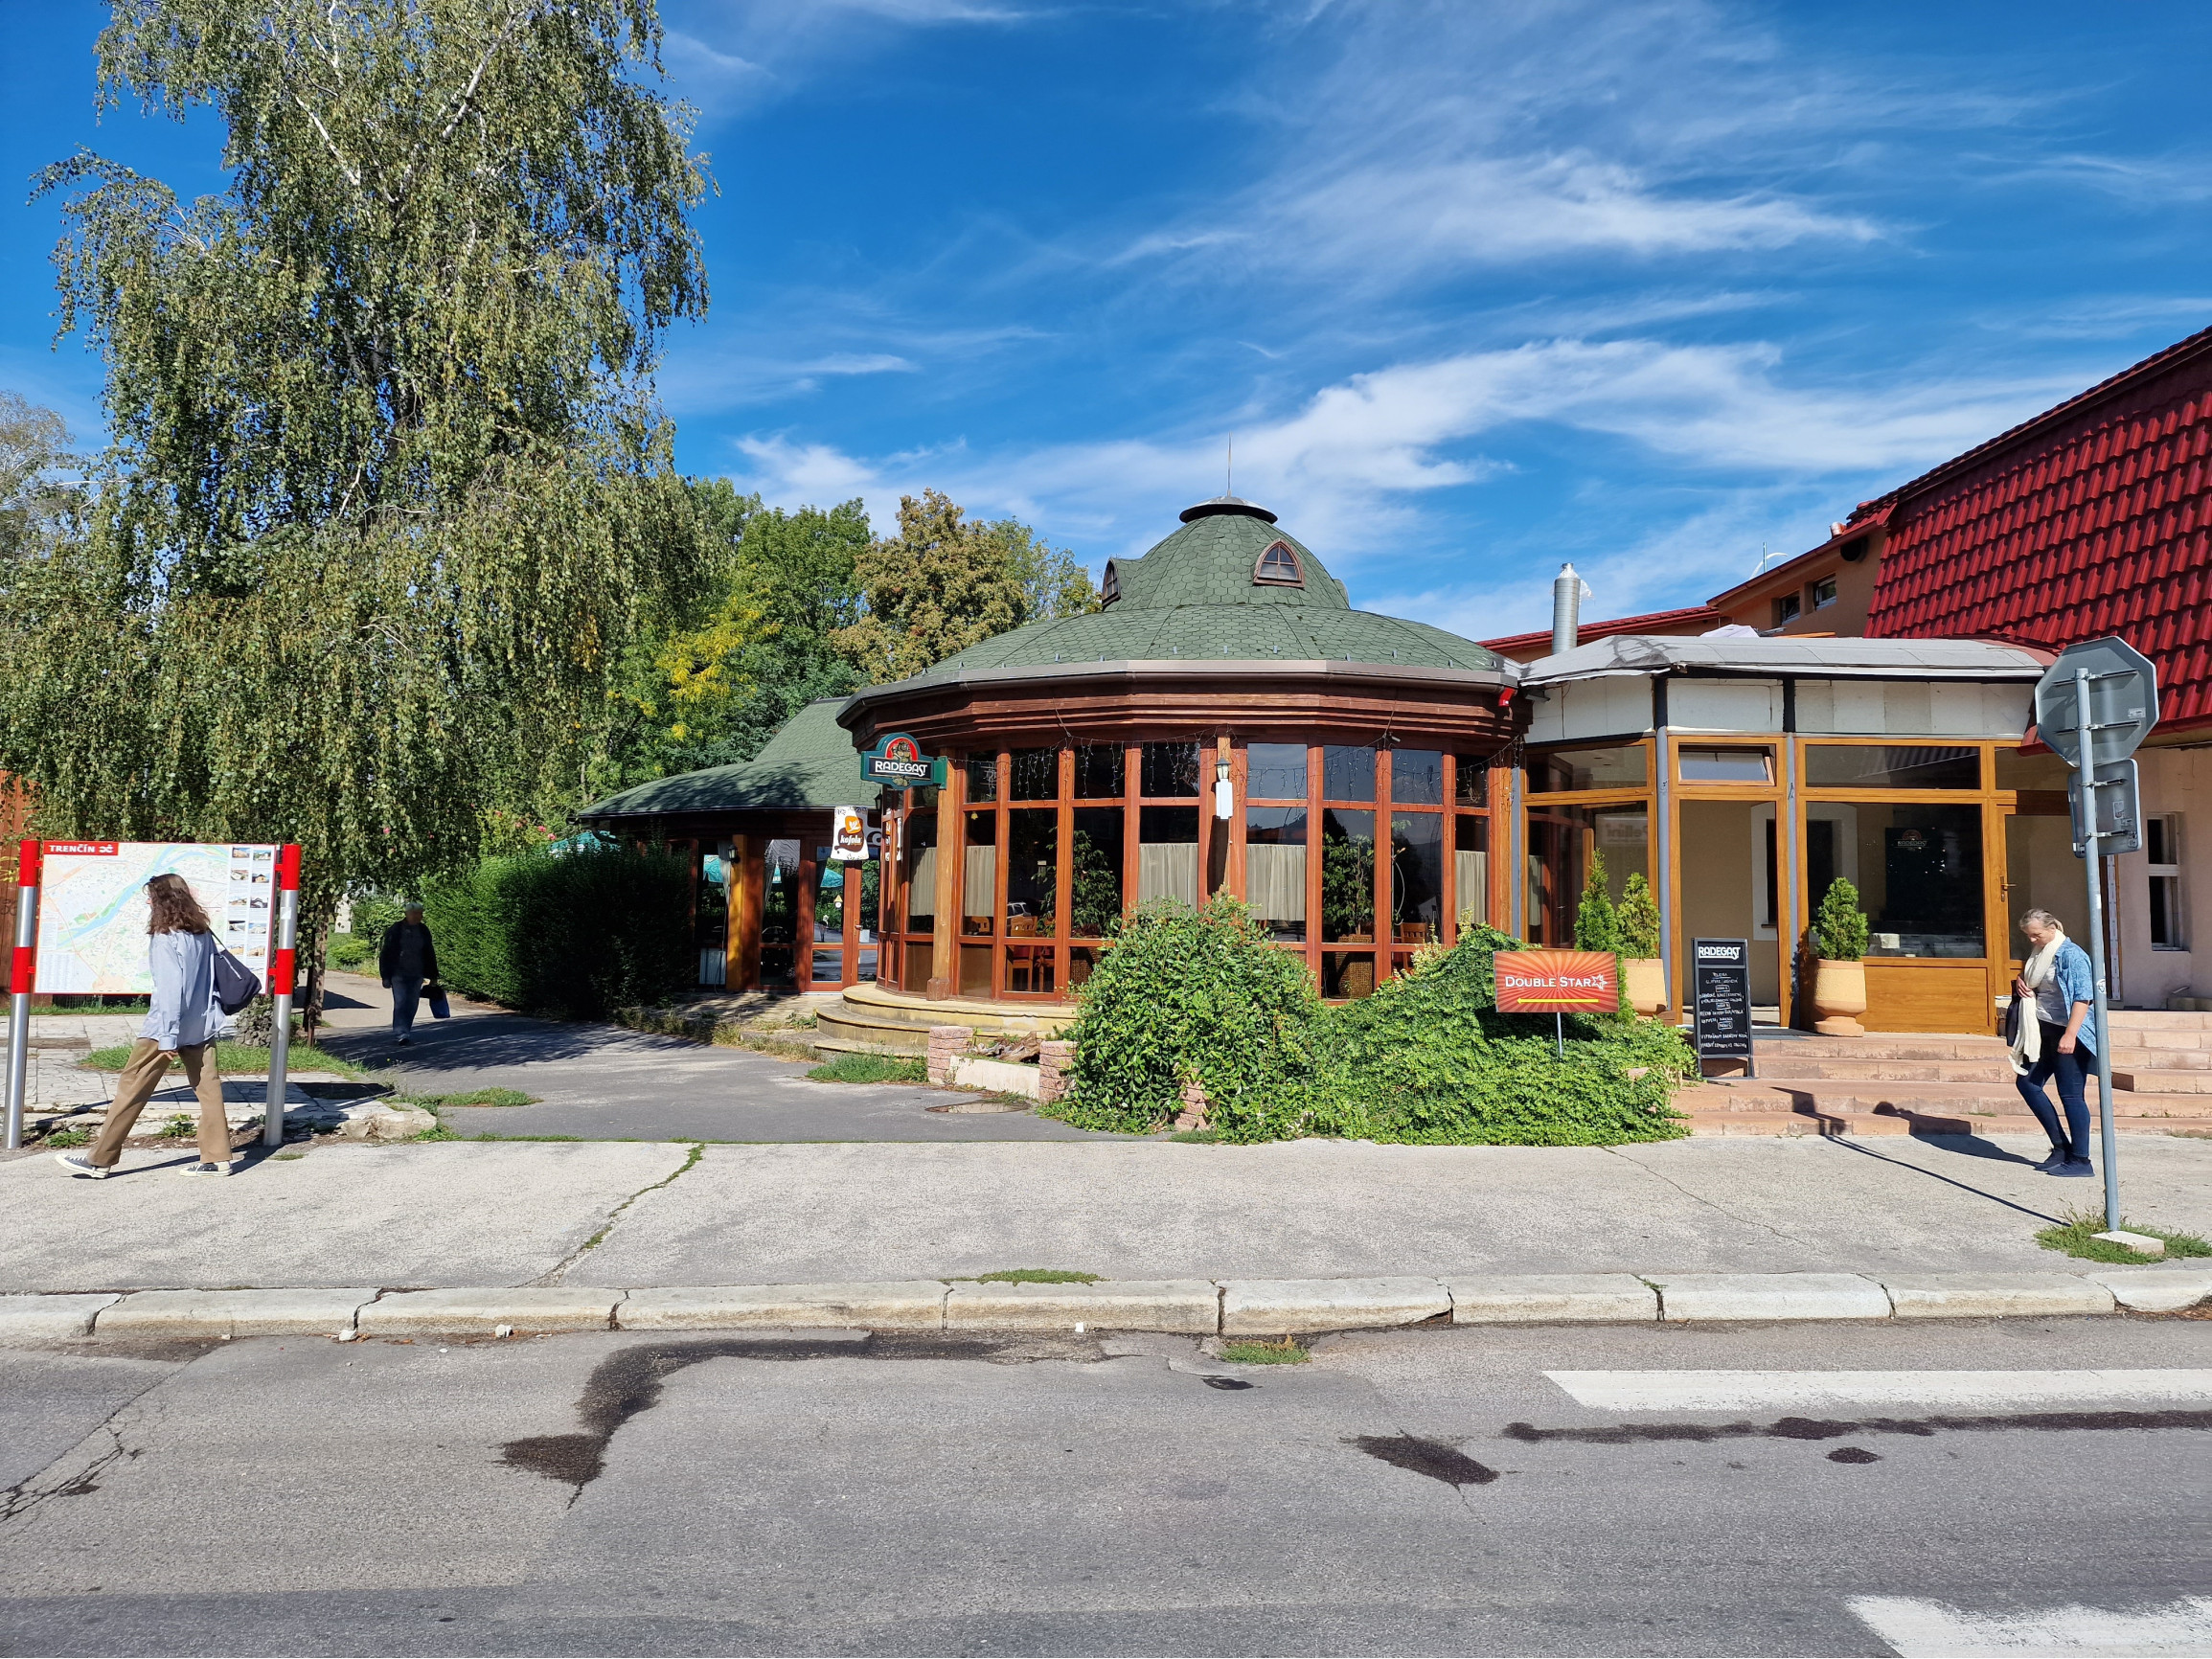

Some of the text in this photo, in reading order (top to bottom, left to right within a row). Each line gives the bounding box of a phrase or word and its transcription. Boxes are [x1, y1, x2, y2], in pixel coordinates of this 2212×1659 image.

[875, 761, 927, 777] RADEGAST
[840, 835, 861, 845] kofola
[49, 844, 95, 852] TRENČÍN
[1698, 946, 1741, 960] RADEGAST
[1505, 976, 1591, 988] DOUBLE STAR
